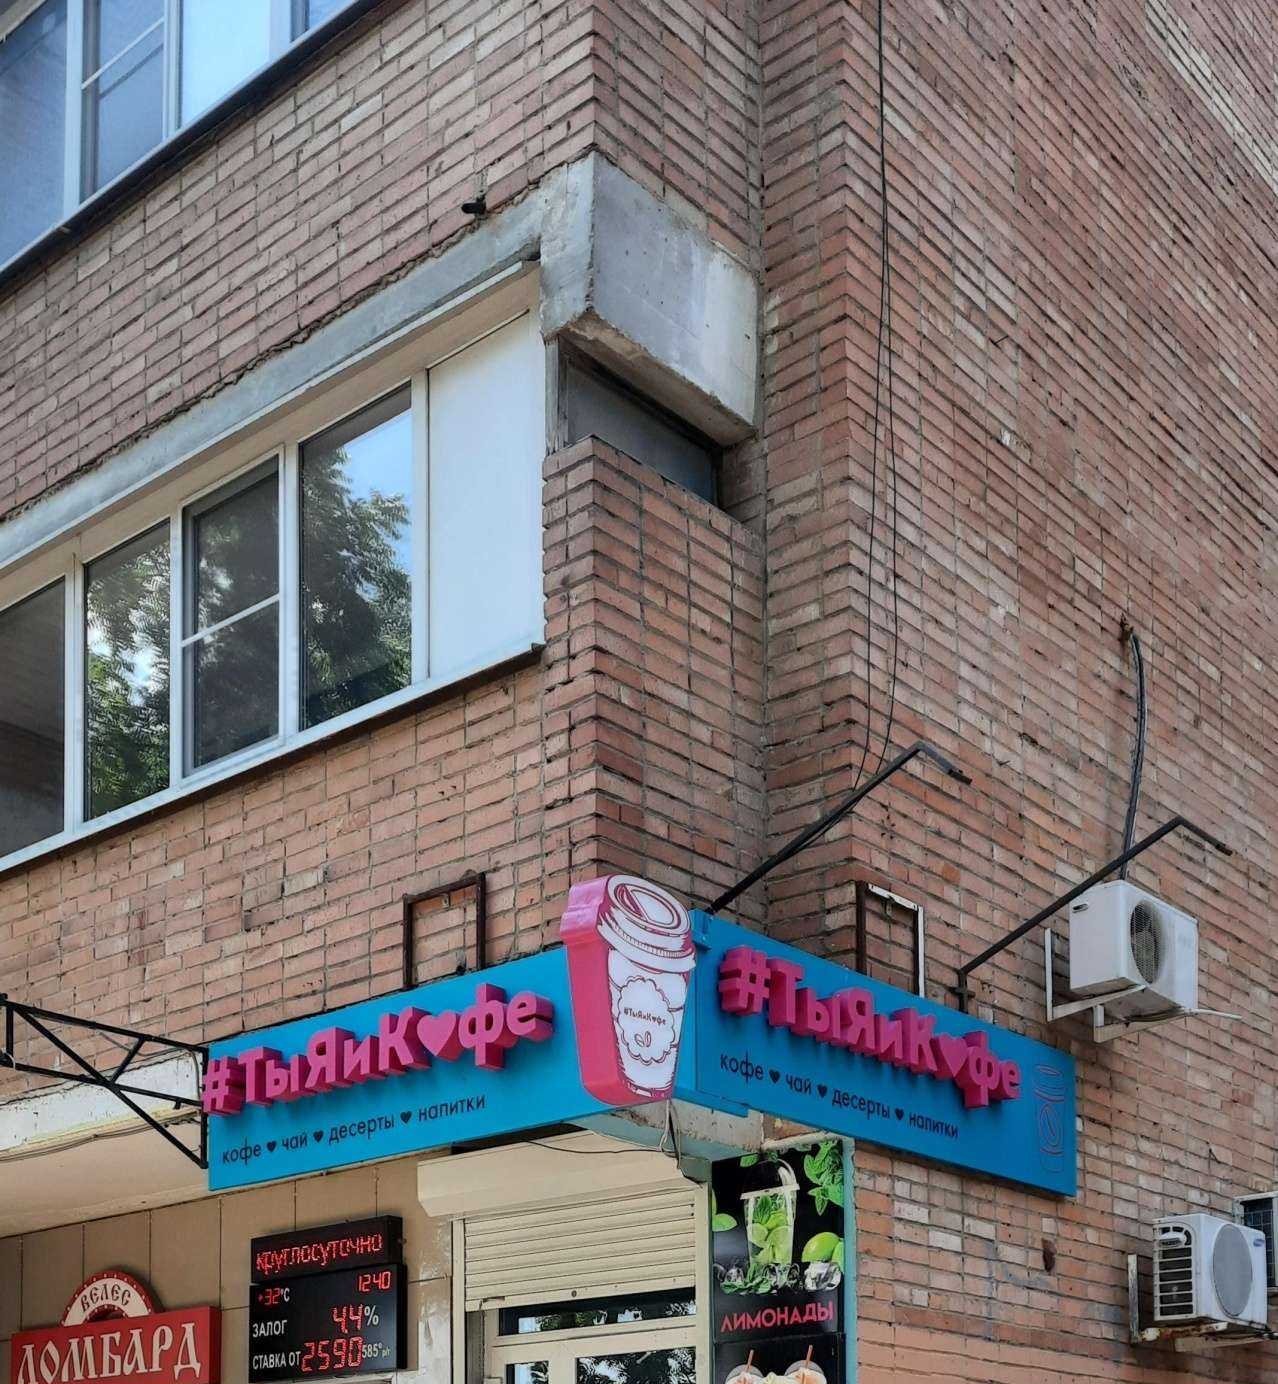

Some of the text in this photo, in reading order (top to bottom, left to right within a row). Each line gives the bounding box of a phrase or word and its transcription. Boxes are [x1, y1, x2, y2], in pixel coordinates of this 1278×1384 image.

[720, 1050, 959, 1140] кофе чай десерты напитки
[222, 1094, 485, 1165] кофе чай десерты напитки
[252, 1320, 287, 1337] ЗАЛОГ
[720, 1301, 834, 1332] ЛИМОНАДЫ
[252, 1353, 286, 1370] СТАВКА
[288, 1351, 301, 1367] ОТ
[301, 1336, 364, 1372] 2590
